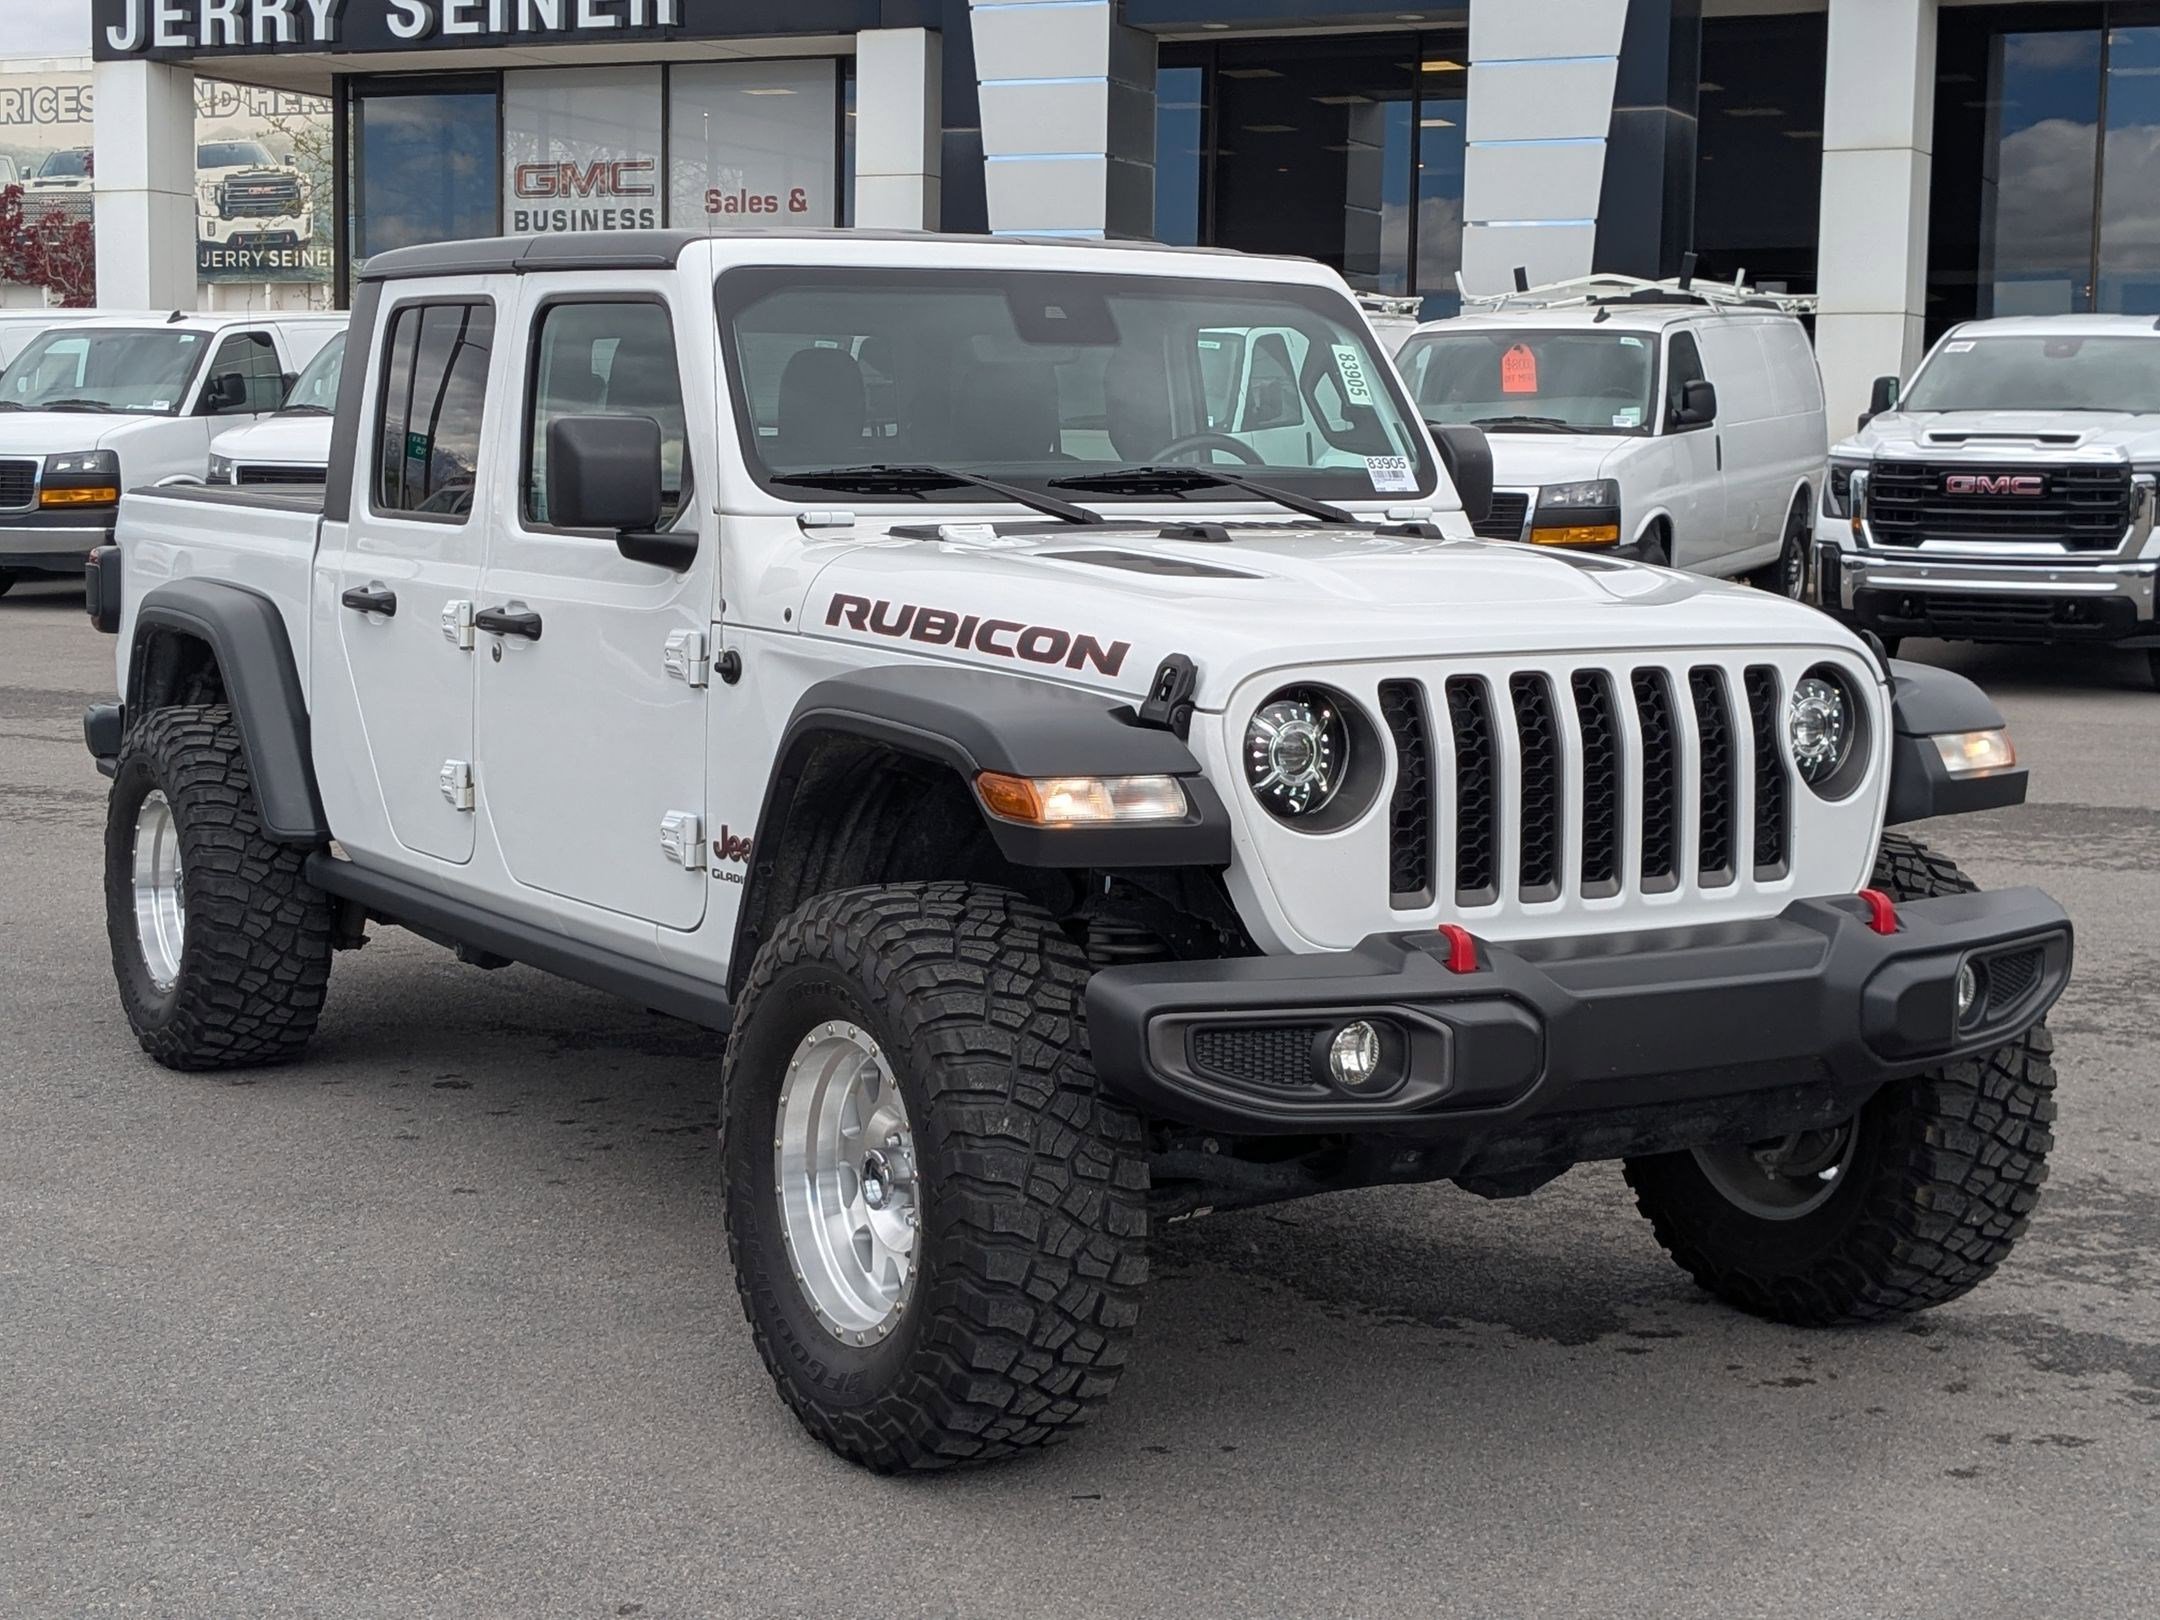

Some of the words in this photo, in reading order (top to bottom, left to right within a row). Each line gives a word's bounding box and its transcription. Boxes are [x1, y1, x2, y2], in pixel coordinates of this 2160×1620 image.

[106, 0, 341, 51] JERRY
[513, 159, 656, 199] GMC
[705, 188, 779, 214] Sales
[788, 187, 809, 214] &
[513, 207, 656, 232] BUSINESS
[200, 249, 264, 268] JERRY
[1338, 352, 1368, 398] 83905
[1366, 457, 1407, 470] 83905
[1946, 475, 2043, 495] GMC
[824, 592, 1132, 677] RUBICON
